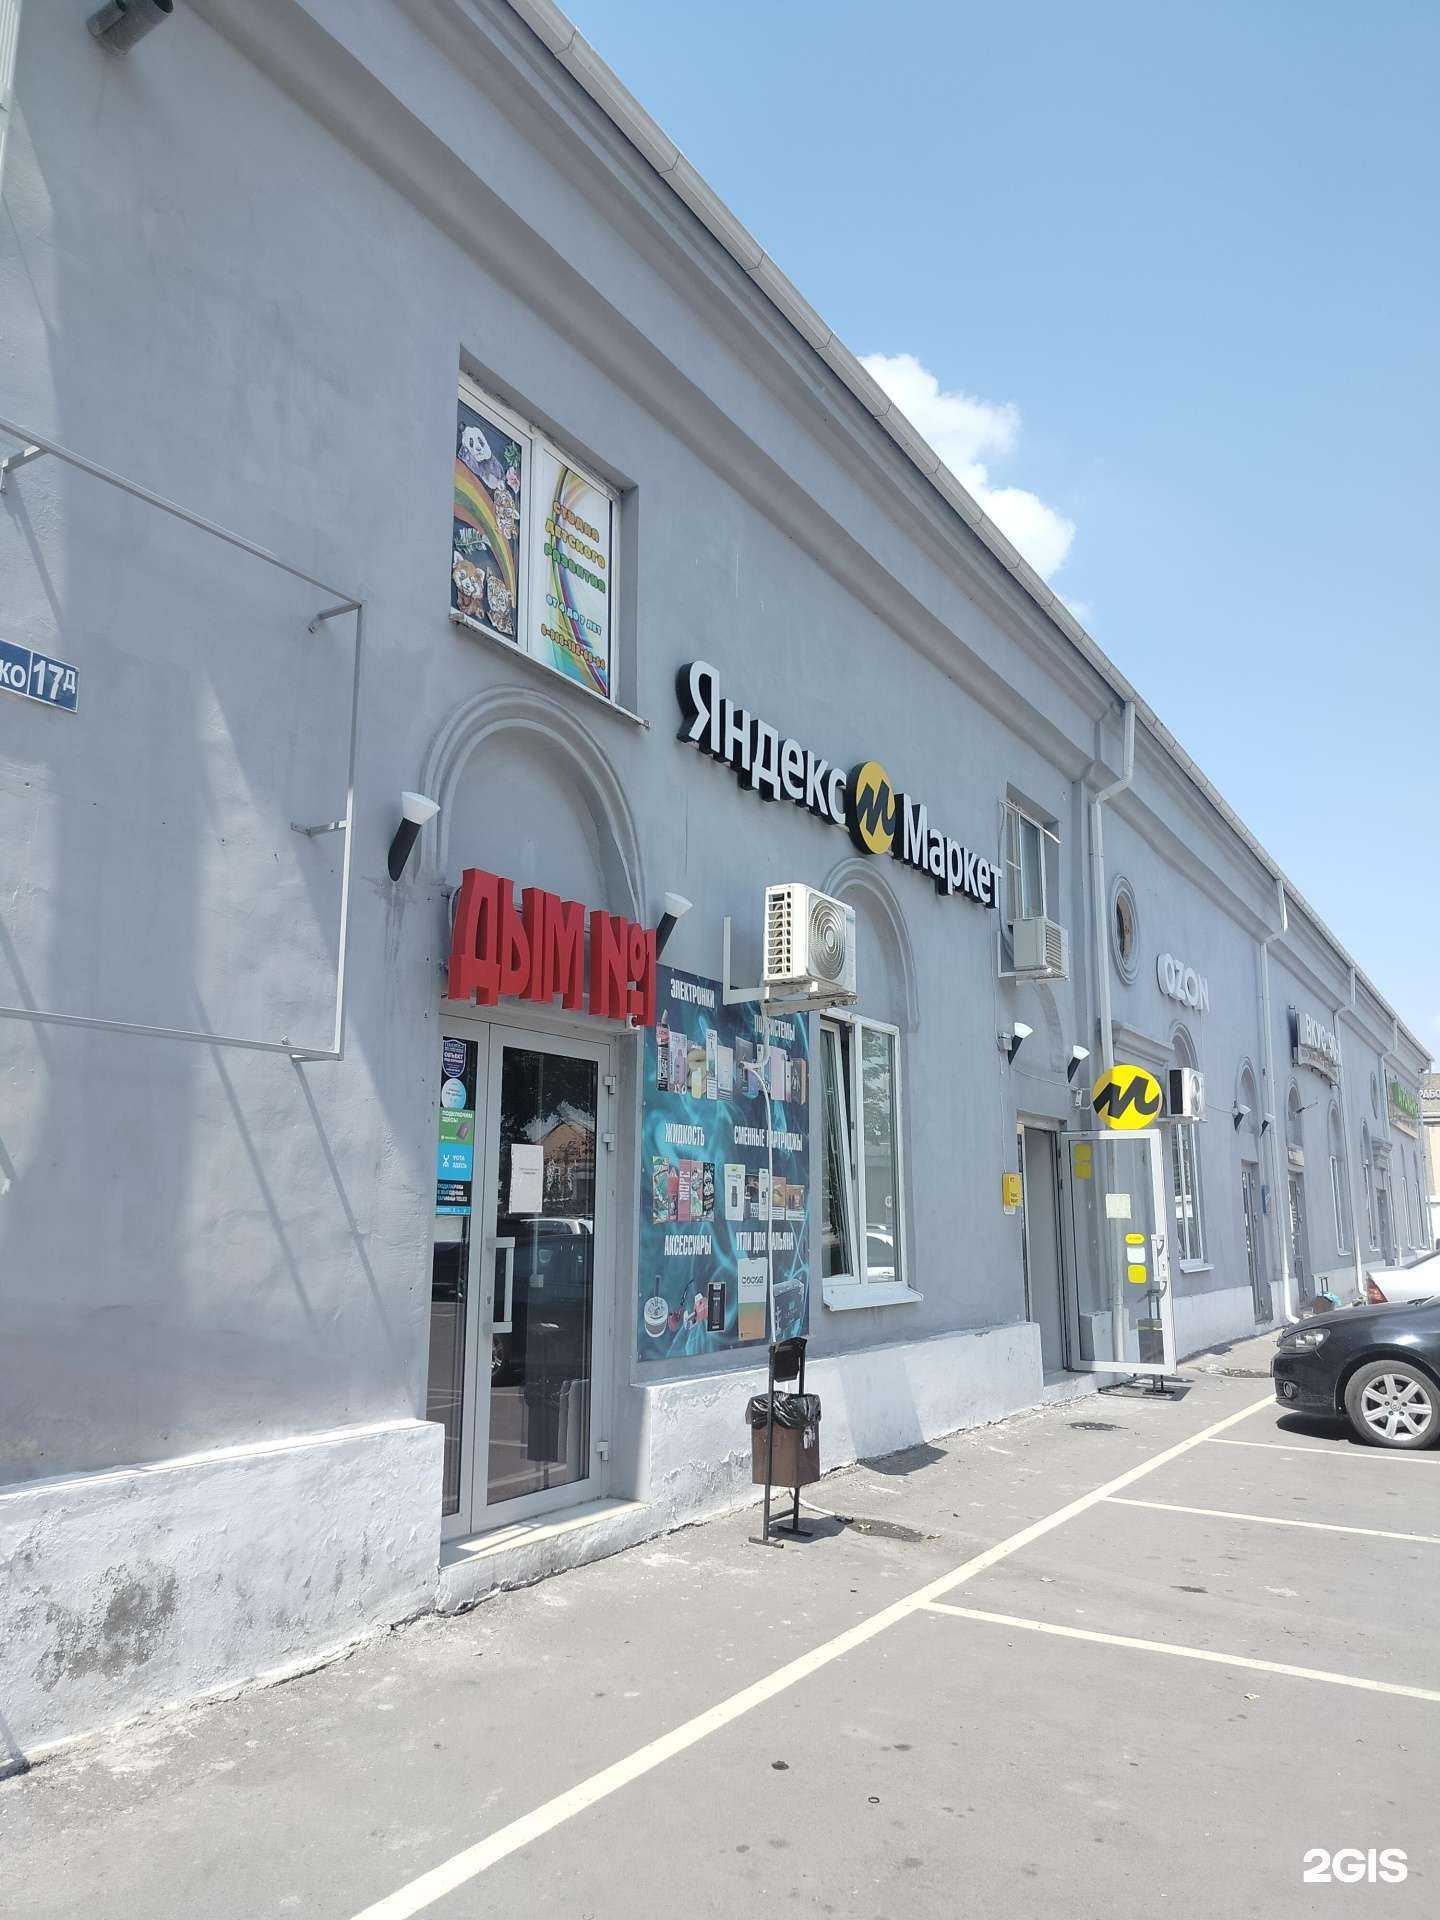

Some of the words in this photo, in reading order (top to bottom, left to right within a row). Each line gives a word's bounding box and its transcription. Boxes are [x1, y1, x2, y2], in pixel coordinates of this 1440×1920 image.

[544, 543, 606, 593] РАЗВИТИЯ
[680, 660, 848, 826] Яндекс
[900, 793, 1003, 910] Маркет
[449, 868, 586, 1011] ДЫМ
[1156, 953, 1210, 1013] OZON
[665, 1122, 705, 1147] ЖИДКОСТЬ
[734, 1125, 765, 1148] СМЕННЫЕ
[664, 1234, 712, 1256] АКСЕССУАРЫ
